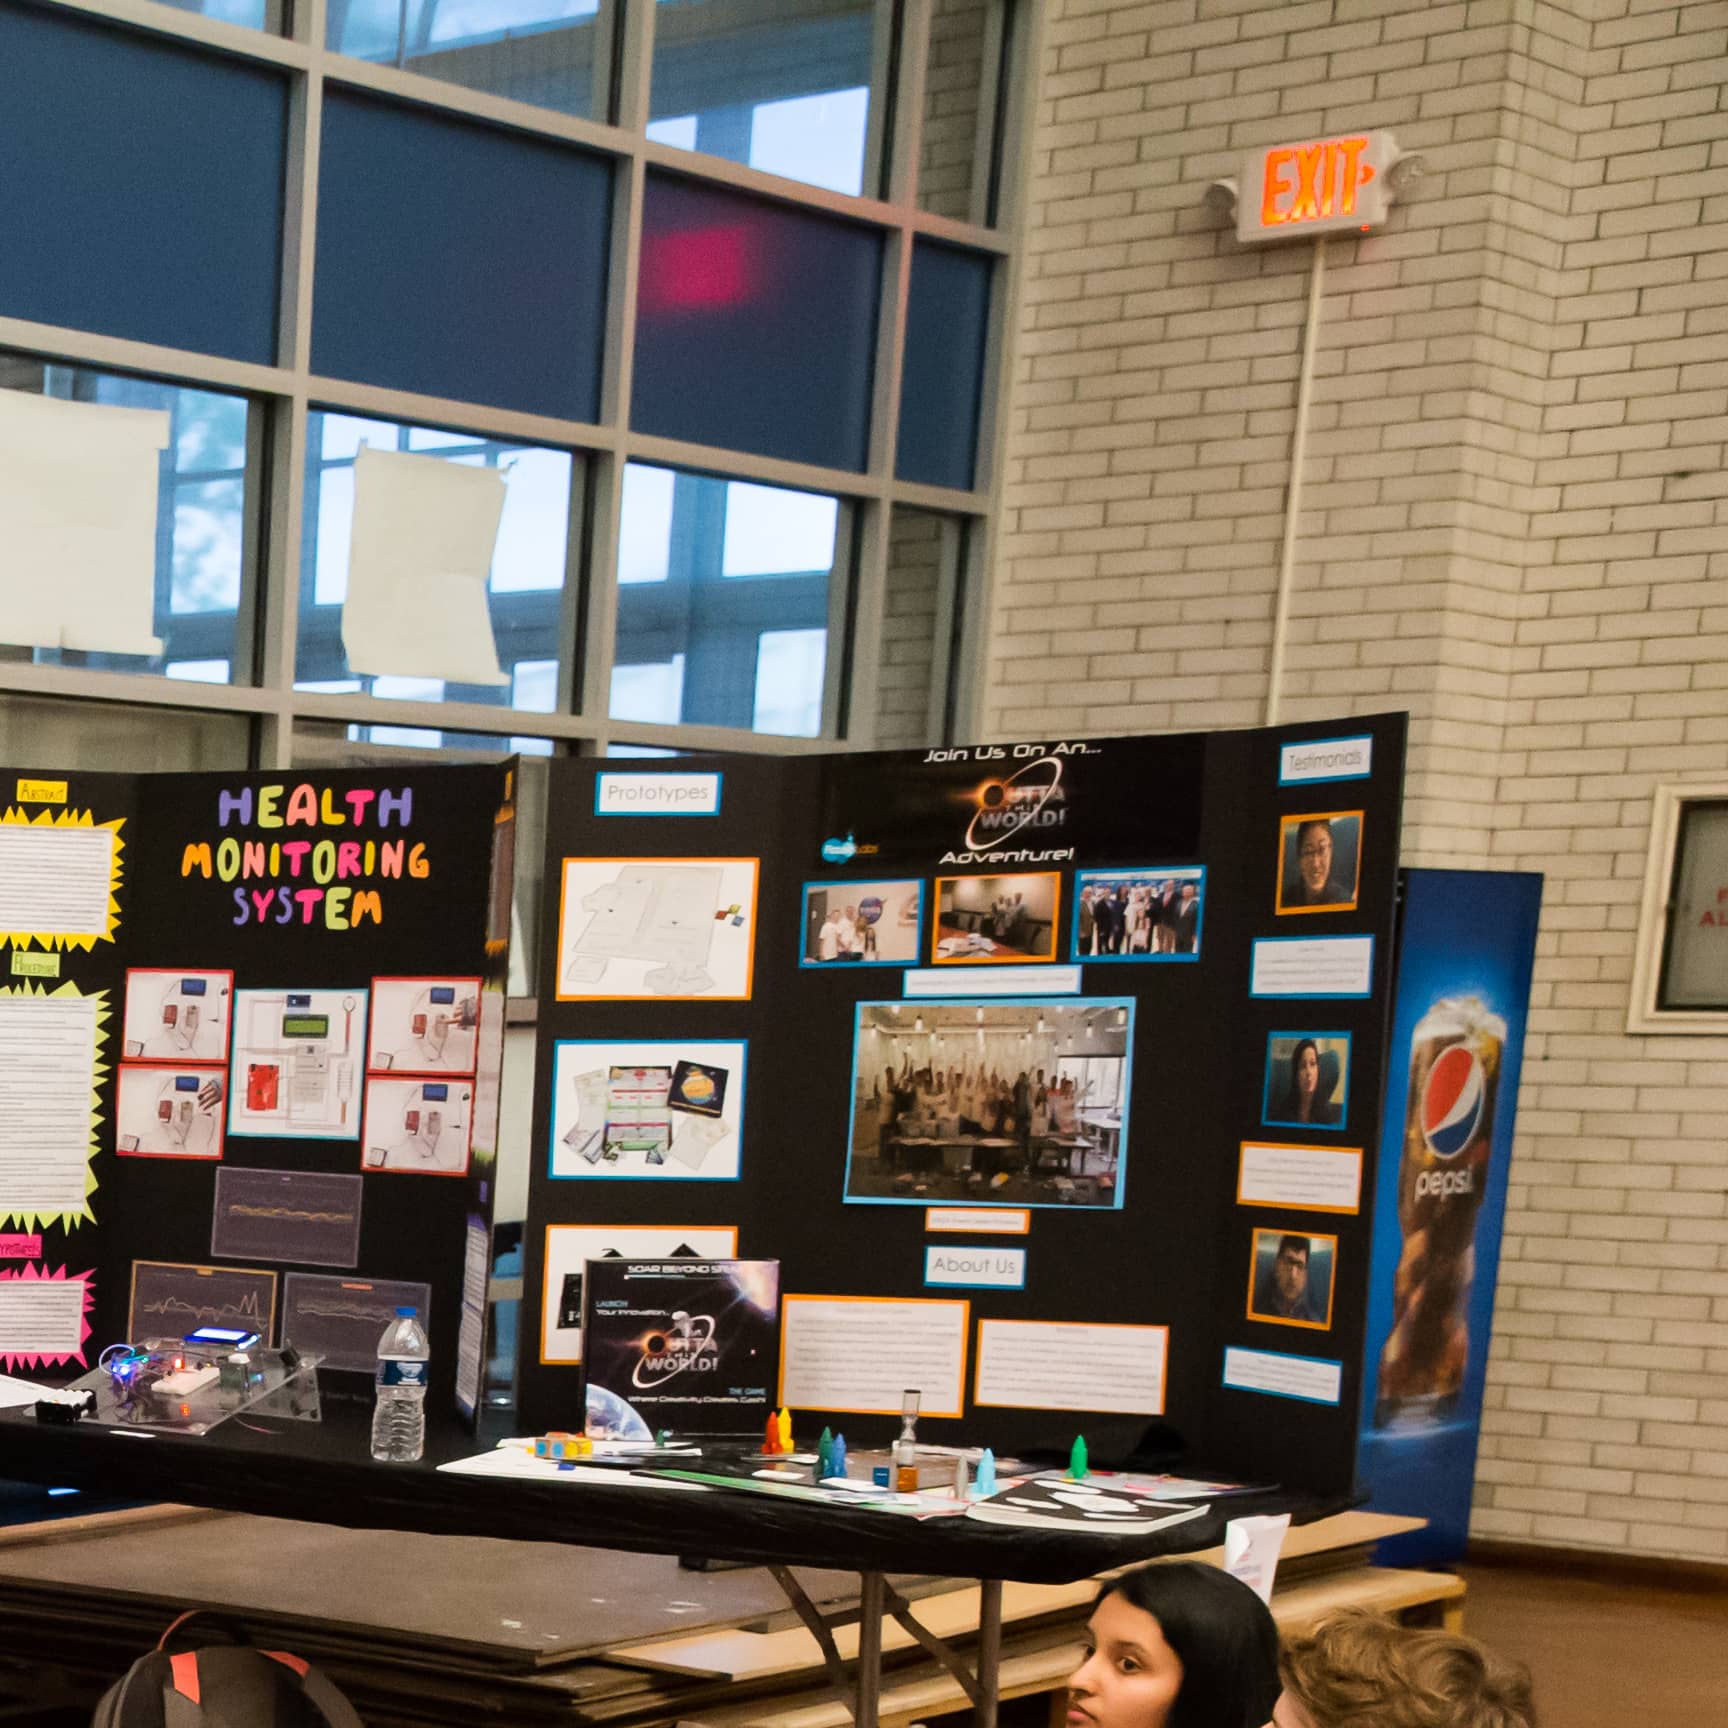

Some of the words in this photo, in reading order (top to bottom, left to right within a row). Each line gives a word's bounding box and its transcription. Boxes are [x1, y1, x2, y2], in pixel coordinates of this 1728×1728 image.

[1260, 136, 1369, 227] EXIT
[923, 749, 968, 763] Join
[976, 746, 1006, 760] Us
[1013, 744, 1045, 757] On
[218, 784, 412, 828] HEALTH
[608, 785, 708, 802] Prototypes
[181, 838, 430, 884] MONITORING
[940, 848, 1074, 864] Adventure!
[233, 886, 382, 930] SYSTEM
[1414, 1164, 1473, 1204] pepsi
[933, 1256, 990, 1274] About
[996, 1258, 1016, 1275] Us
